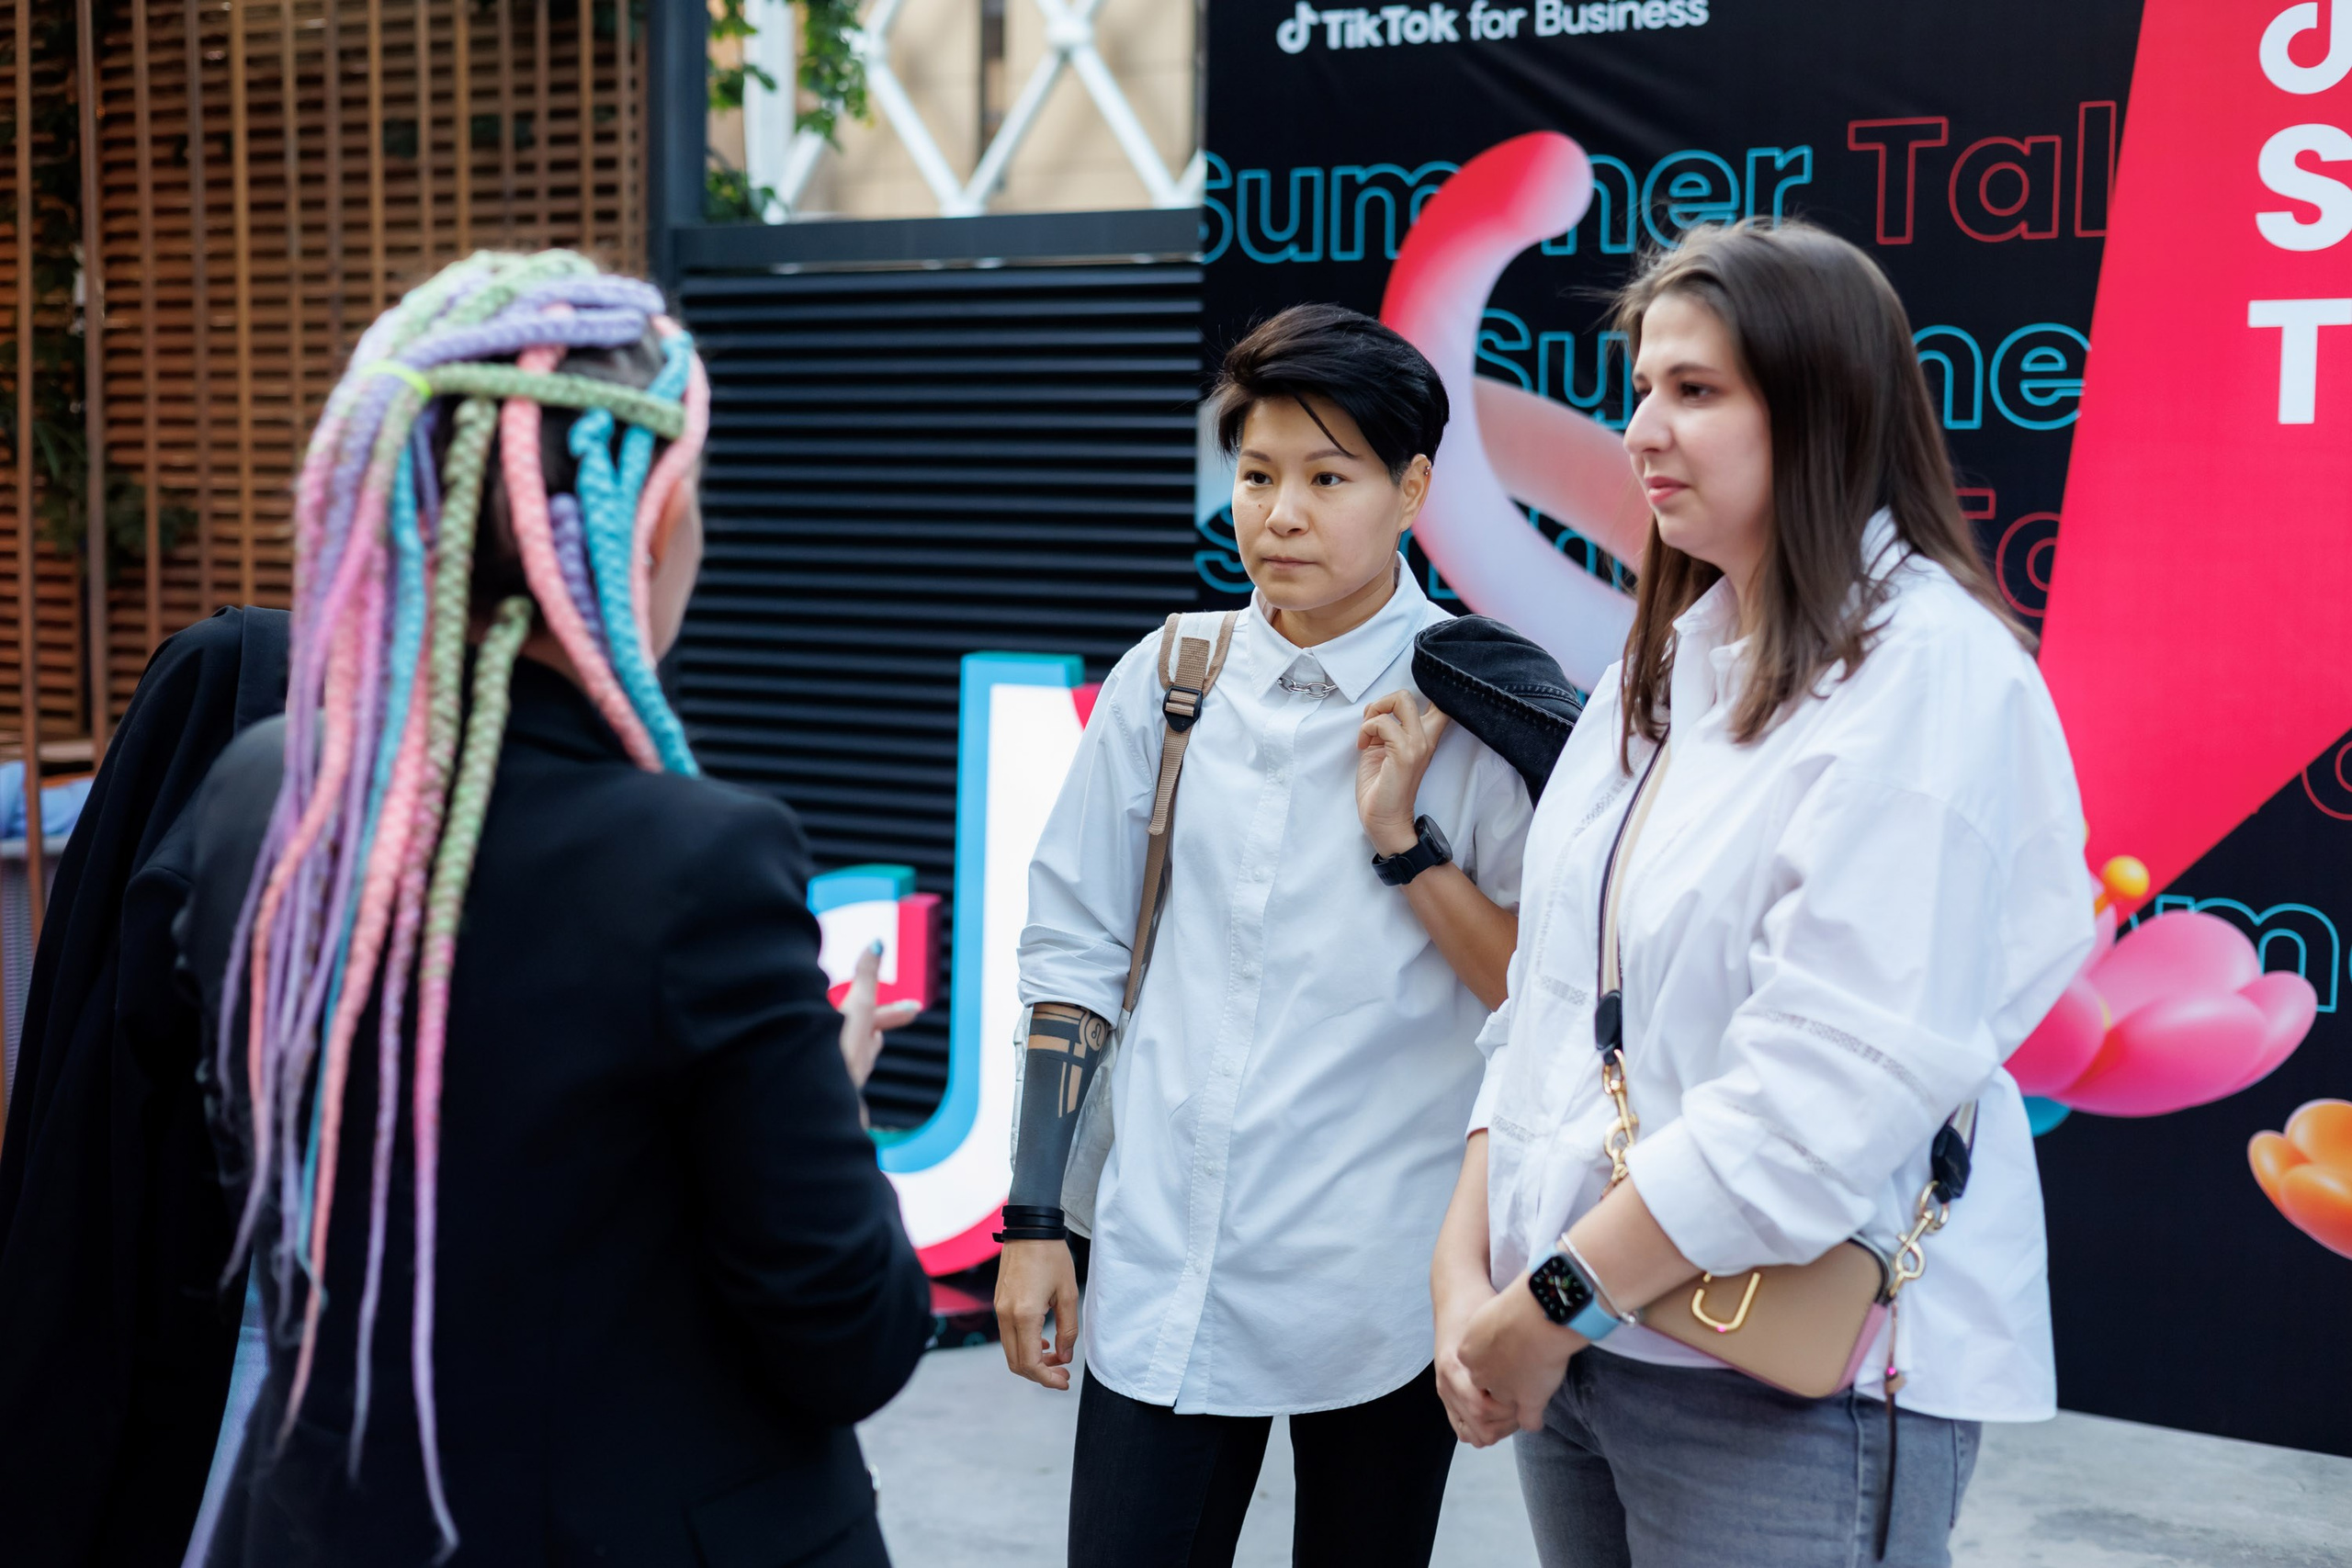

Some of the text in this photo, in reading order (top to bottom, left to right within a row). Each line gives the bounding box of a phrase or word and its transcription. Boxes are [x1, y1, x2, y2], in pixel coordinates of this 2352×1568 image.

[1320, 0, 1710, 51] TikTok for Business
